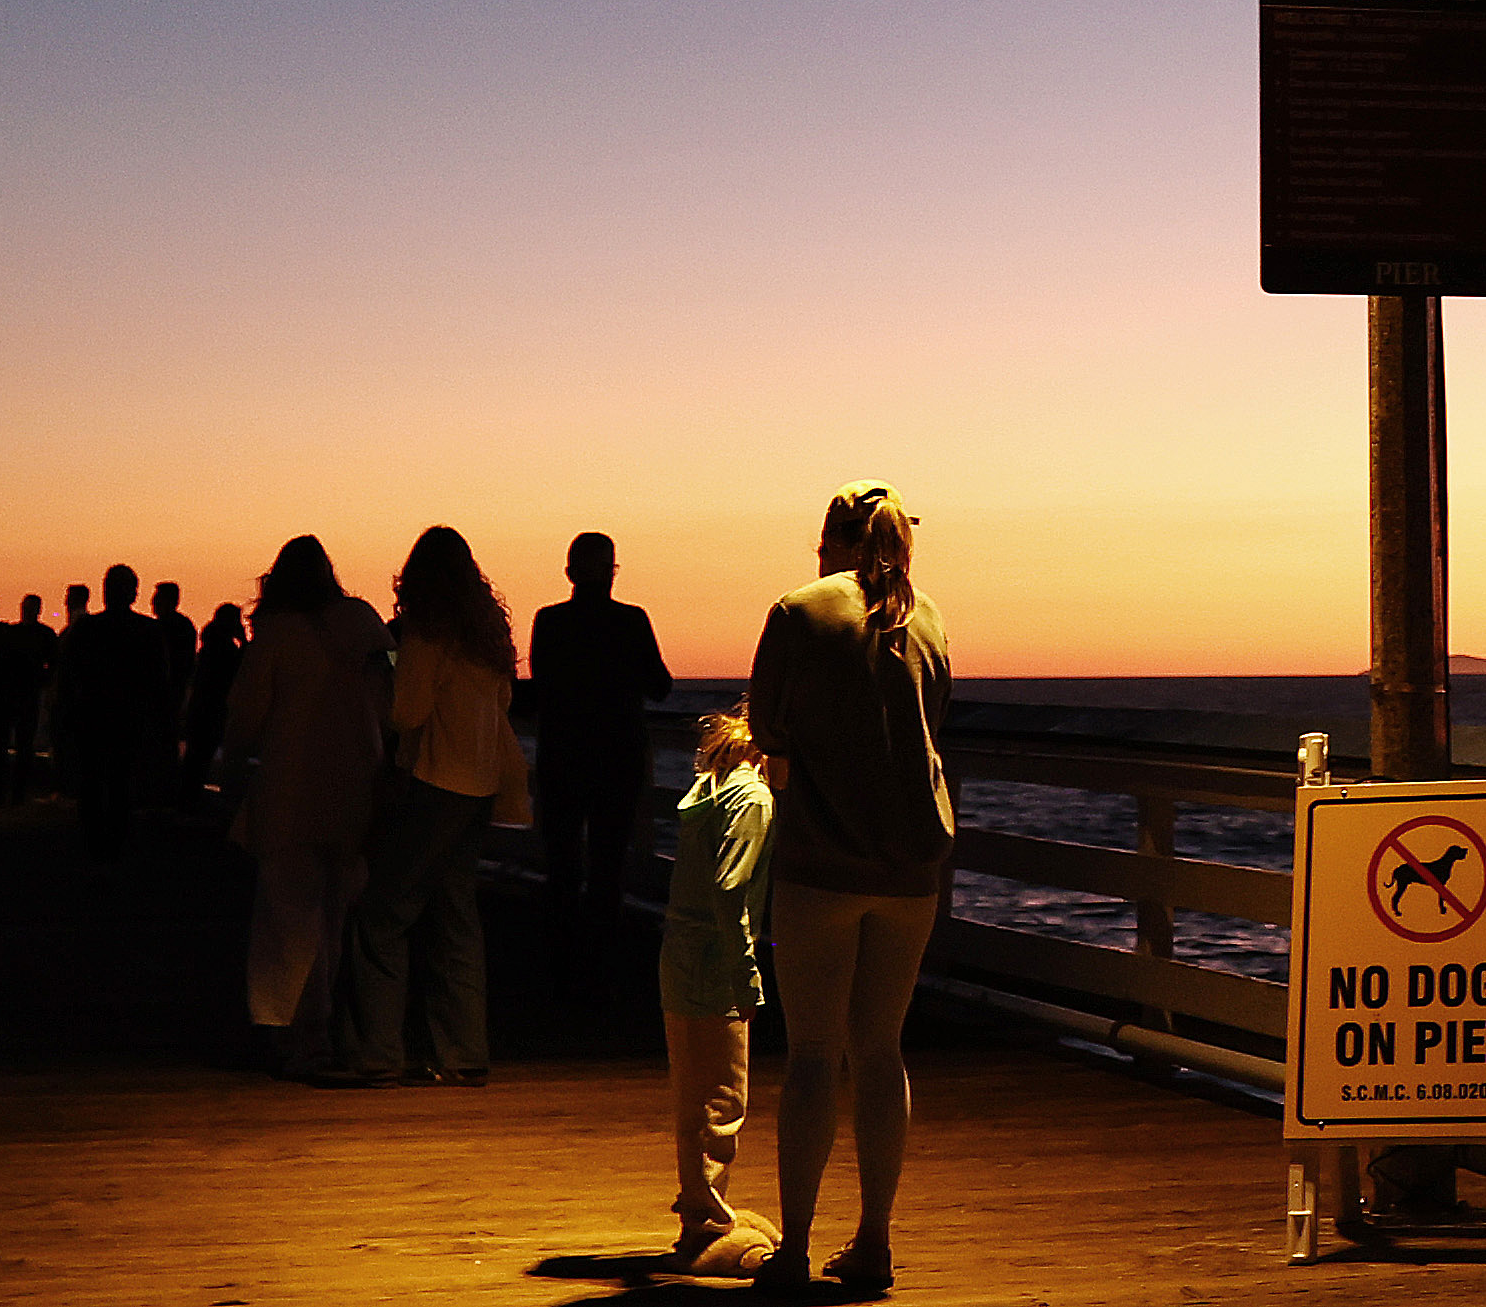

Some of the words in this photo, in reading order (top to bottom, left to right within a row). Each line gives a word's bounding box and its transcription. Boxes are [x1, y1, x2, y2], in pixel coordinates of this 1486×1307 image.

[1375, 261, 1442, 285] PIER
[1329, 964, 1390, 1010] NO
[1335, 1020, 1396, 1068] ON
[1341, 1084, 1411, 1102] S.C.M.C.
